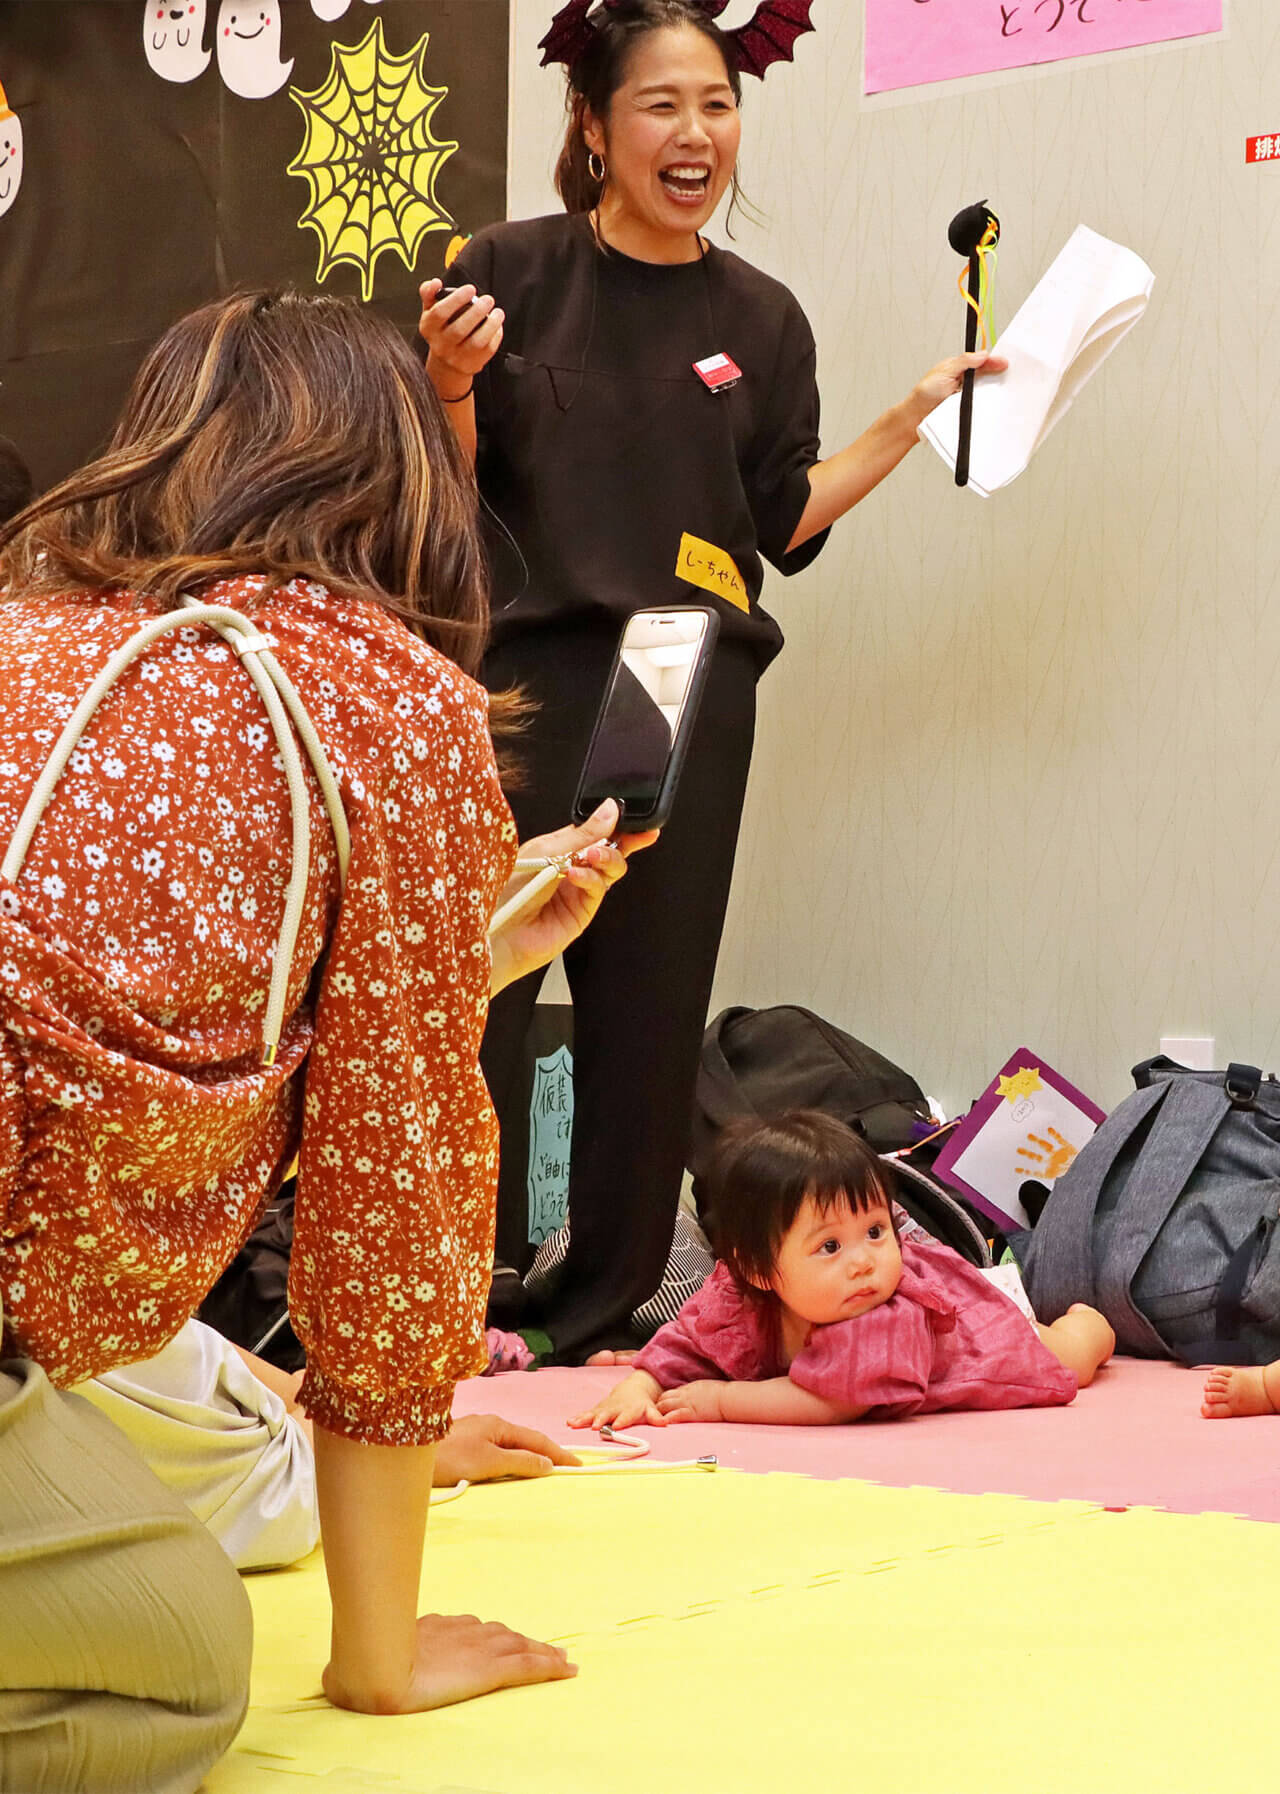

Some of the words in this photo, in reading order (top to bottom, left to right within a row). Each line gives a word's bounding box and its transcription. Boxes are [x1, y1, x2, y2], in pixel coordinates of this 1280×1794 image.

[686, 549, 739, 591] しーちゃん
